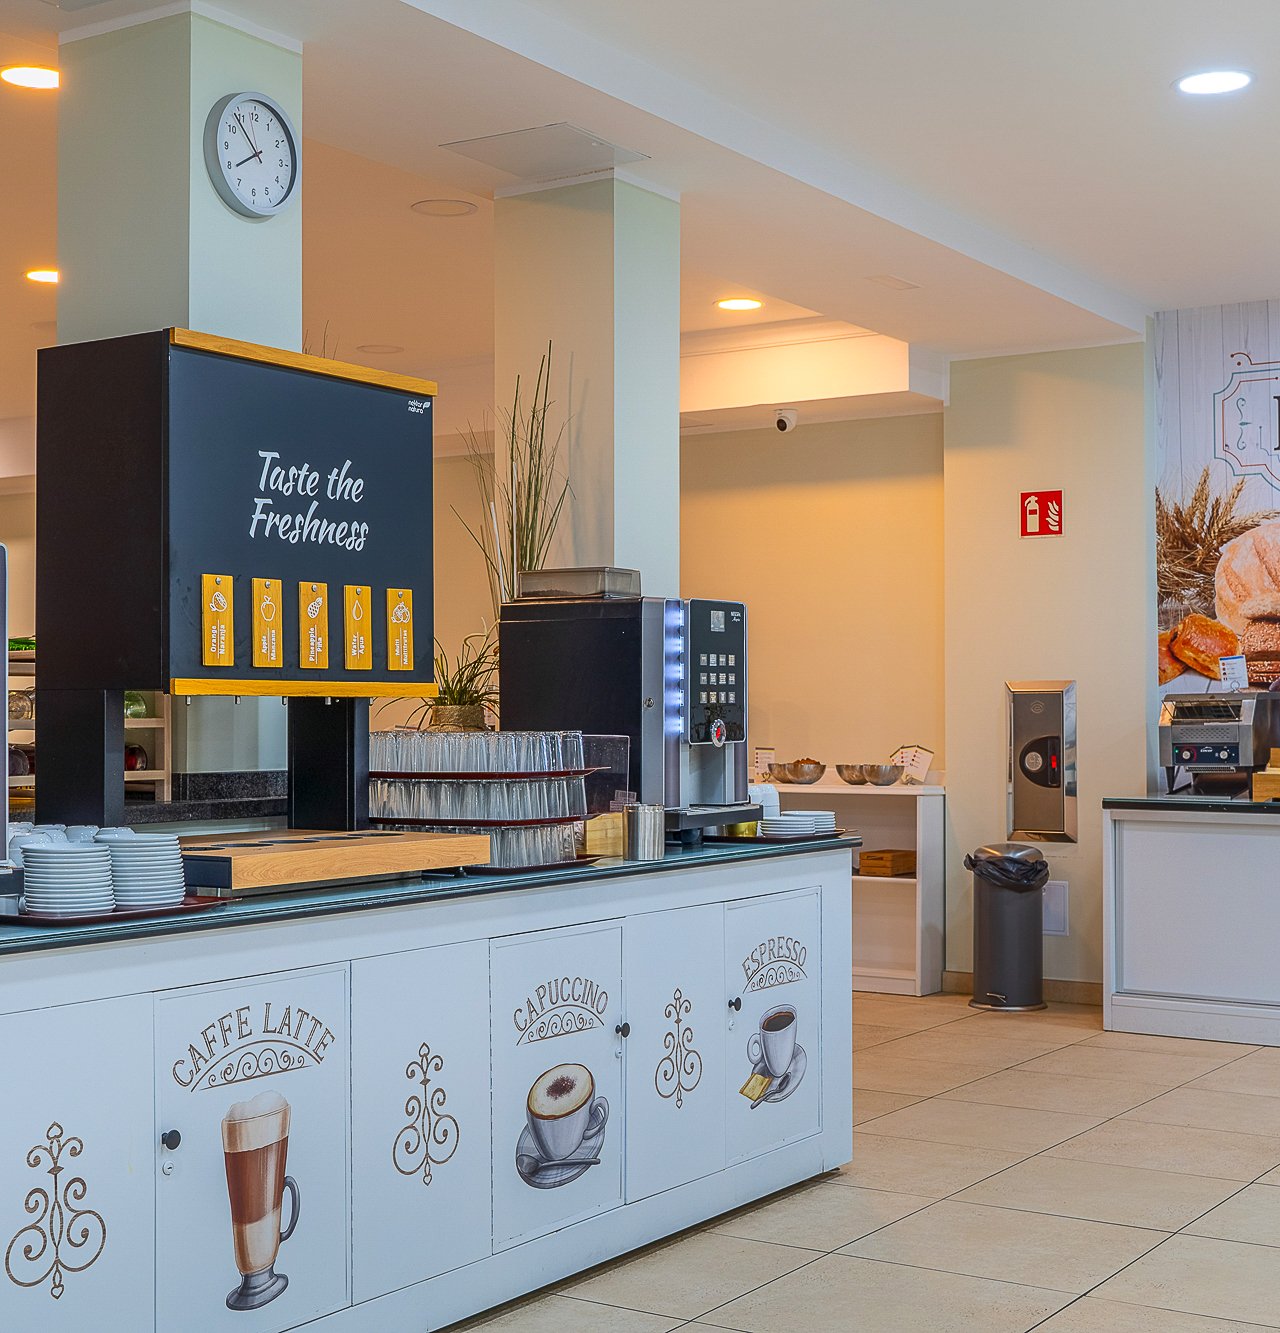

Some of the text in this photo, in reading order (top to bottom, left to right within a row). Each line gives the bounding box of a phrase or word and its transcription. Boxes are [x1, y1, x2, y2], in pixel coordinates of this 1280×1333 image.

[251, 113, 259, 122] 12
[228, 124, 237, 134] 10
[224, 141, 229, 150] 9
[275, 139, 280, 149] 2
[227, 161, 232, 169] 8
[278, 159, 284, 168] 3
[236, 178, 242, 186] 7
[274, 175, 279, 184] 4
[251, 188, 256, 197] 6
[264, 187, 269, 196] 5
[258, 450, 365, 503] Taste the
[248, 497, 369, 551] Freshness
[742, 936, 807, 980] ESPRESSO
[513, 976, 609, 1032] CAPUCCINO
[172, 1002, 336, 1087] CAFFE LATTE
